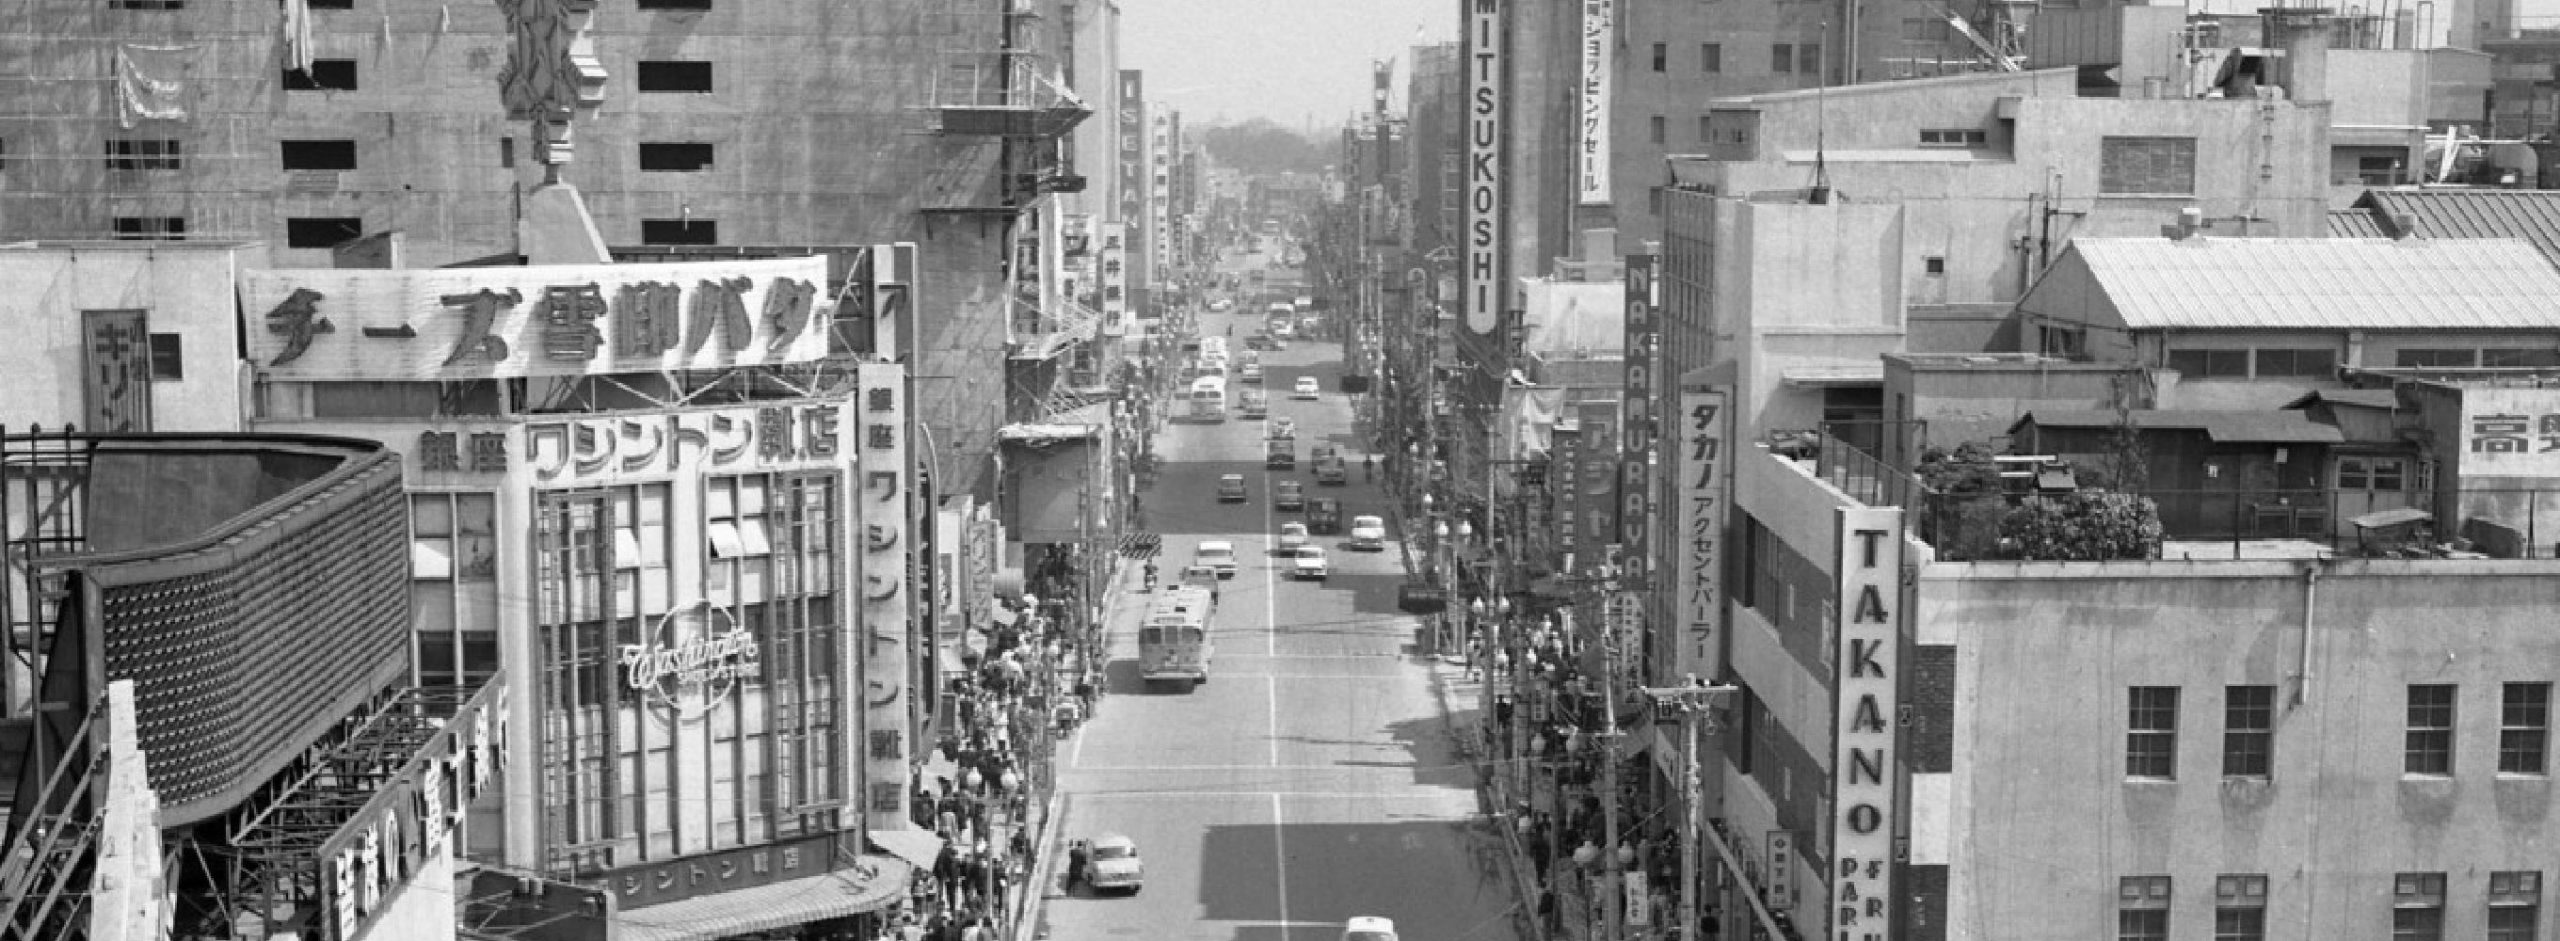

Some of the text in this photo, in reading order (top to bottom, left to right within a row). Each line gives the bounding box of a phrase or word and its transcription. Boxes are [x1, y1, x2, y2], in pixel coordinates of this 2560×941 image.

[1120, 80, 1138, 229] ISETAN
[1473, 0, 1496, 313] MITSUKOSHI
[1626, 268, 1648, 578] NAKAMURAYA
[1690, 404, 1718, 490] タカノ
[1846, 529, 1888, 834] TAKANO
